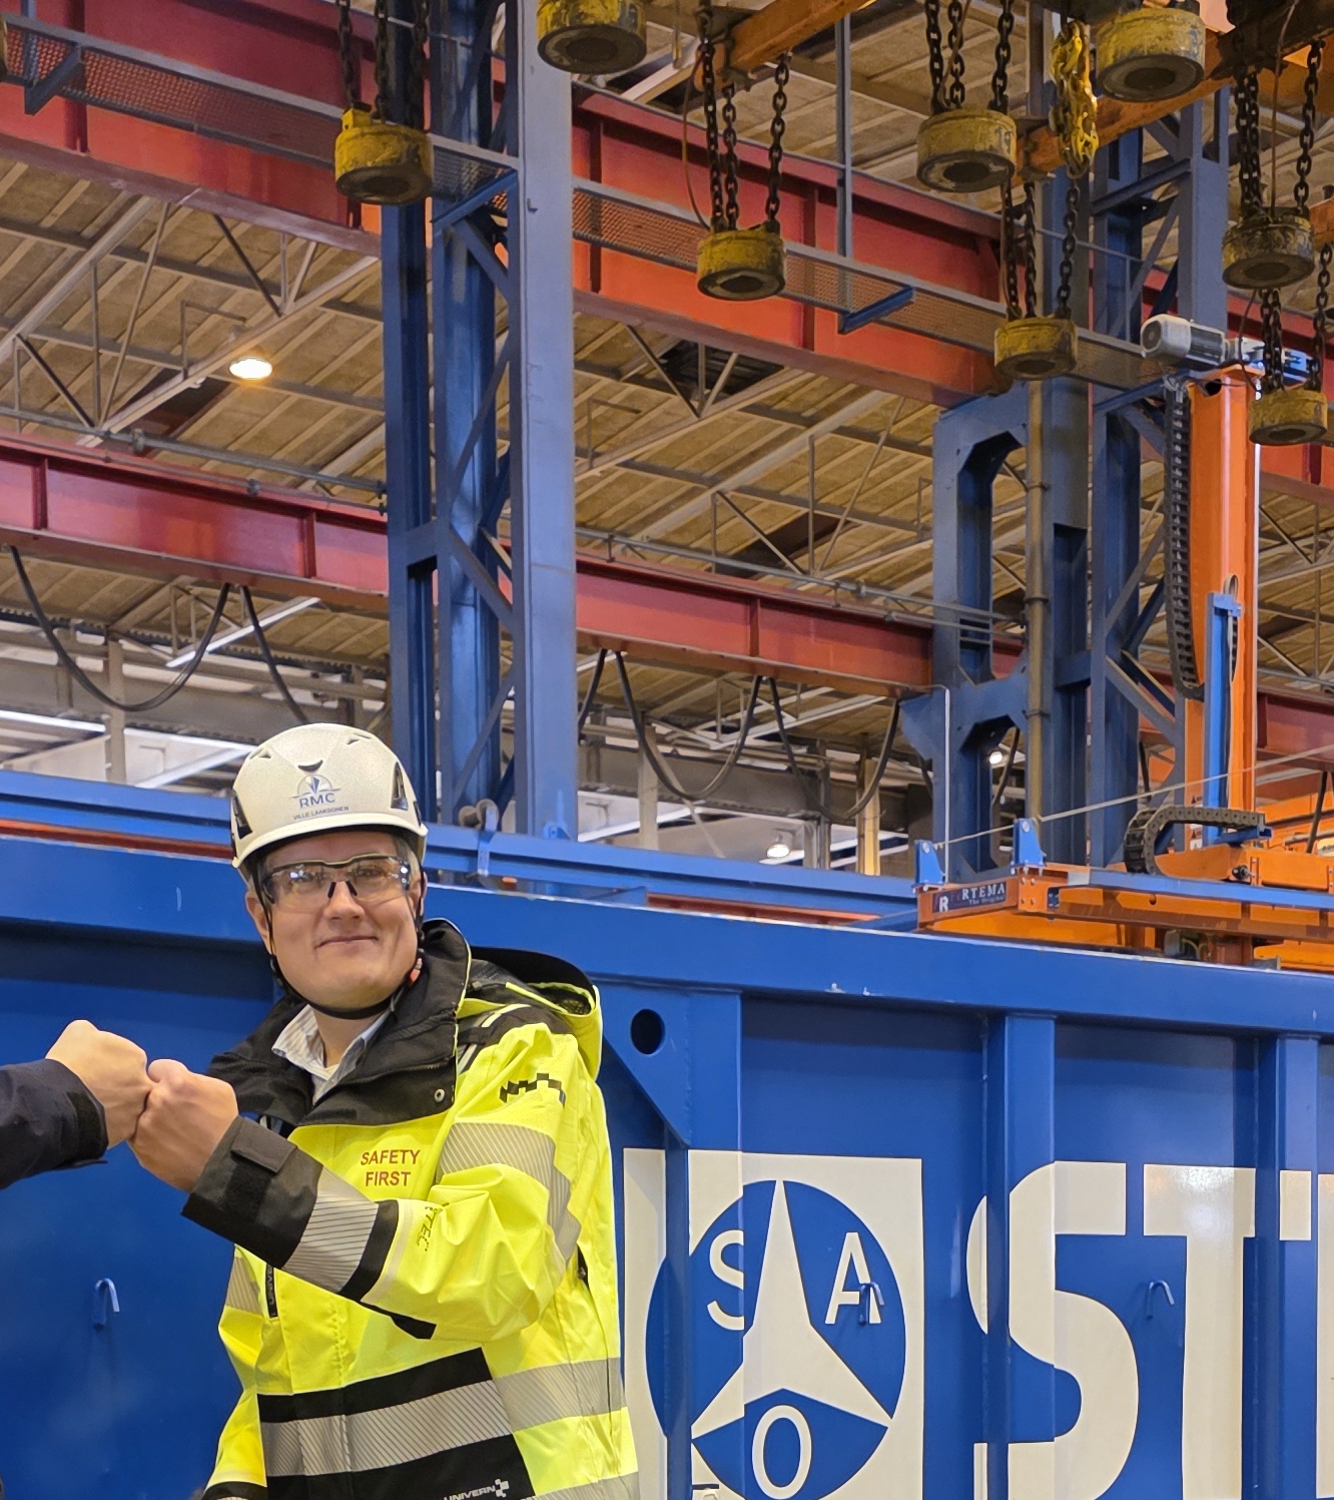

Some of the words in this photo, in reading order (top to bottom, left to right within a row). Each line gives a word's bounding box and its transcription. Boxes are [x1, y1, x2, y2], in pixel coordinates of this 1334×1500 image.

[299, 792, 336, 809] RMC
[360, 1149, 421, 1166] SAFETY
[365, 1171, 411, 1187] FIRST
